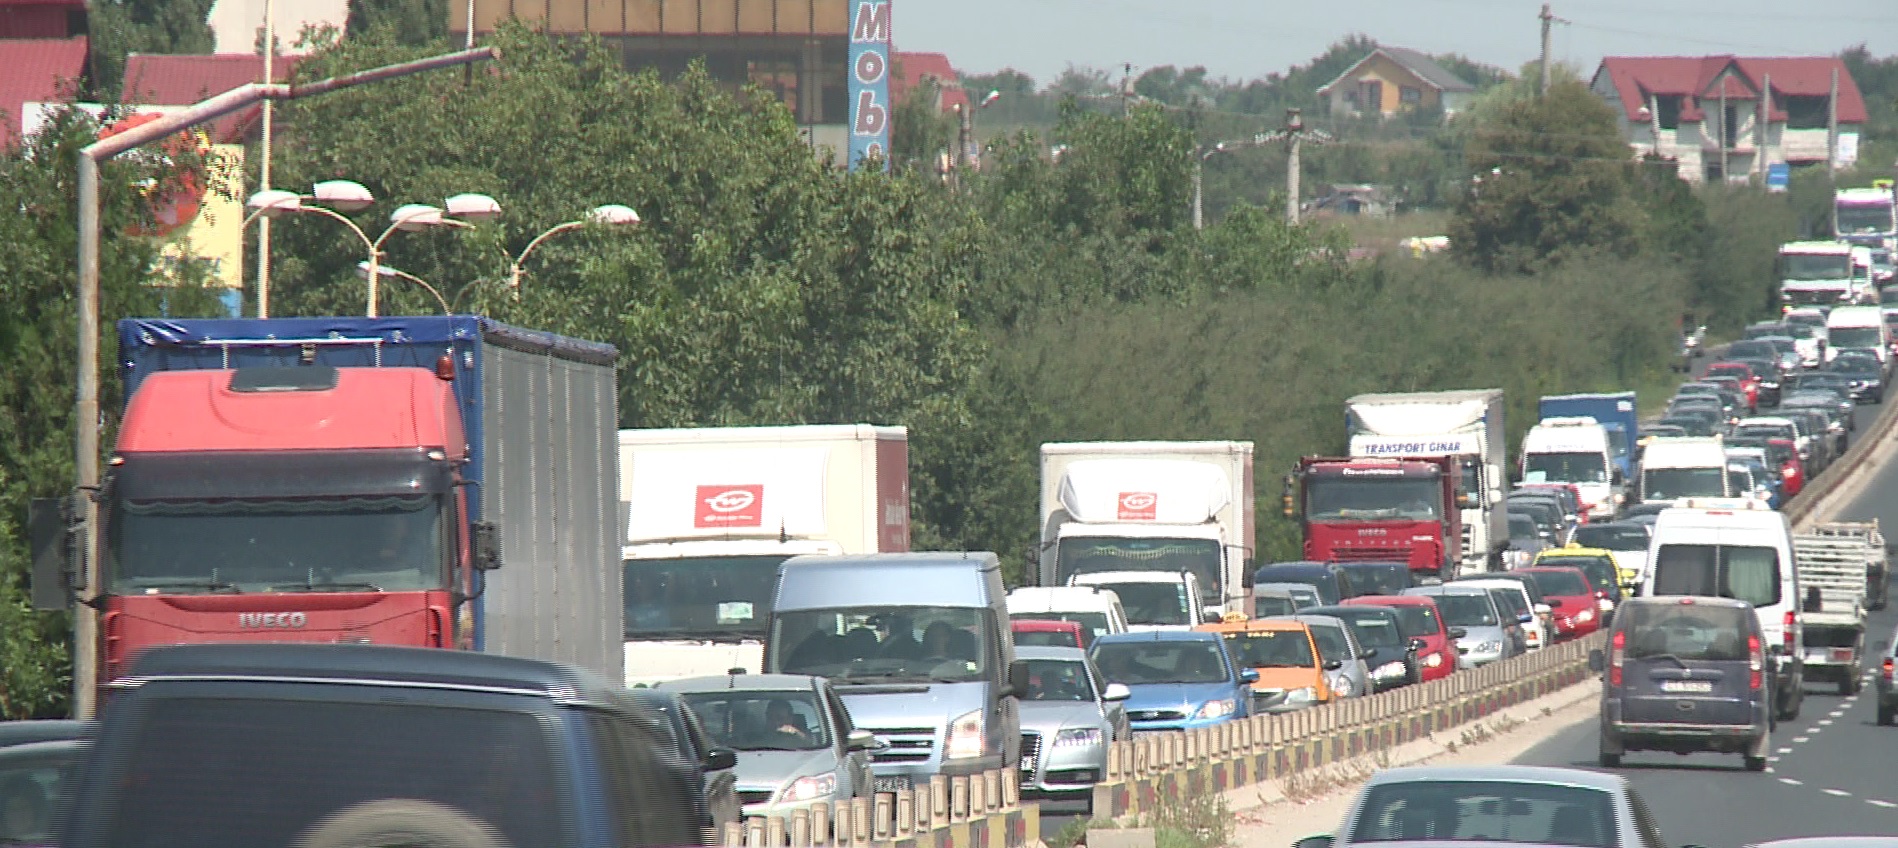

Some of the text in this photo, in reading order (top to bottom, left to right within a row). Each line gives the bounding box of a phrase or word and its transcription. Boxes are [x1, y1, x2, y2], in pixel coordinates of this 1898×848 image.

[1365, 443, 1426, 454] TRANSPORT
[1429, 442, 1461, 452] GINAR
[239, 612, 307, 629] IVECO
